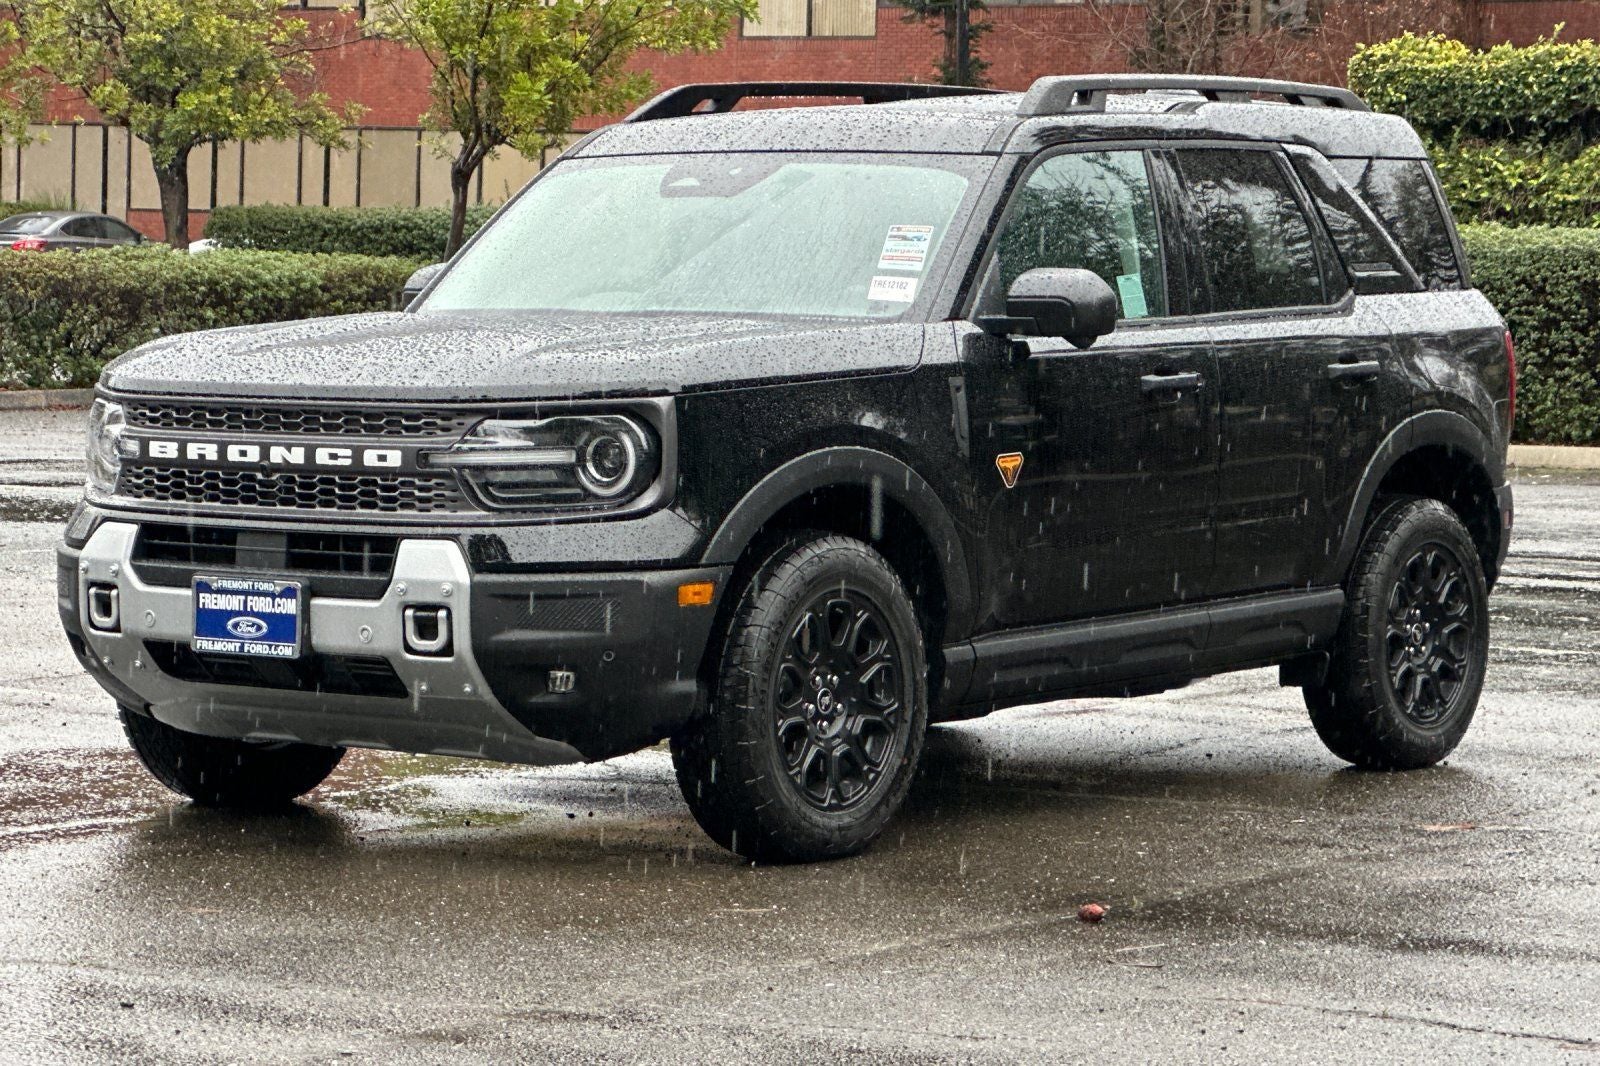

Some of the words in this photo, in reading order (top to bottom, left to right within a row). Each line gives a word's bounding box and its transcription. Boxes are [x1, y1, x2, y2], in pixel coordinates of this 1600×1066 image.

[873, 279, 909, 290] TRE12182
[148, 440, 402, 467] BRONCO
[217, 579, 254, 590] FREMONT
[254, 582, 275, 591] FORD
[199, 592, 245, 611] FREMONT
[247, 596, 297, 614] FORD.COM
[236, 620, 257, 633] Ford
[196, 640, 241, 652] FREMONT
[244, 643, 293, 656] FORD.COM
